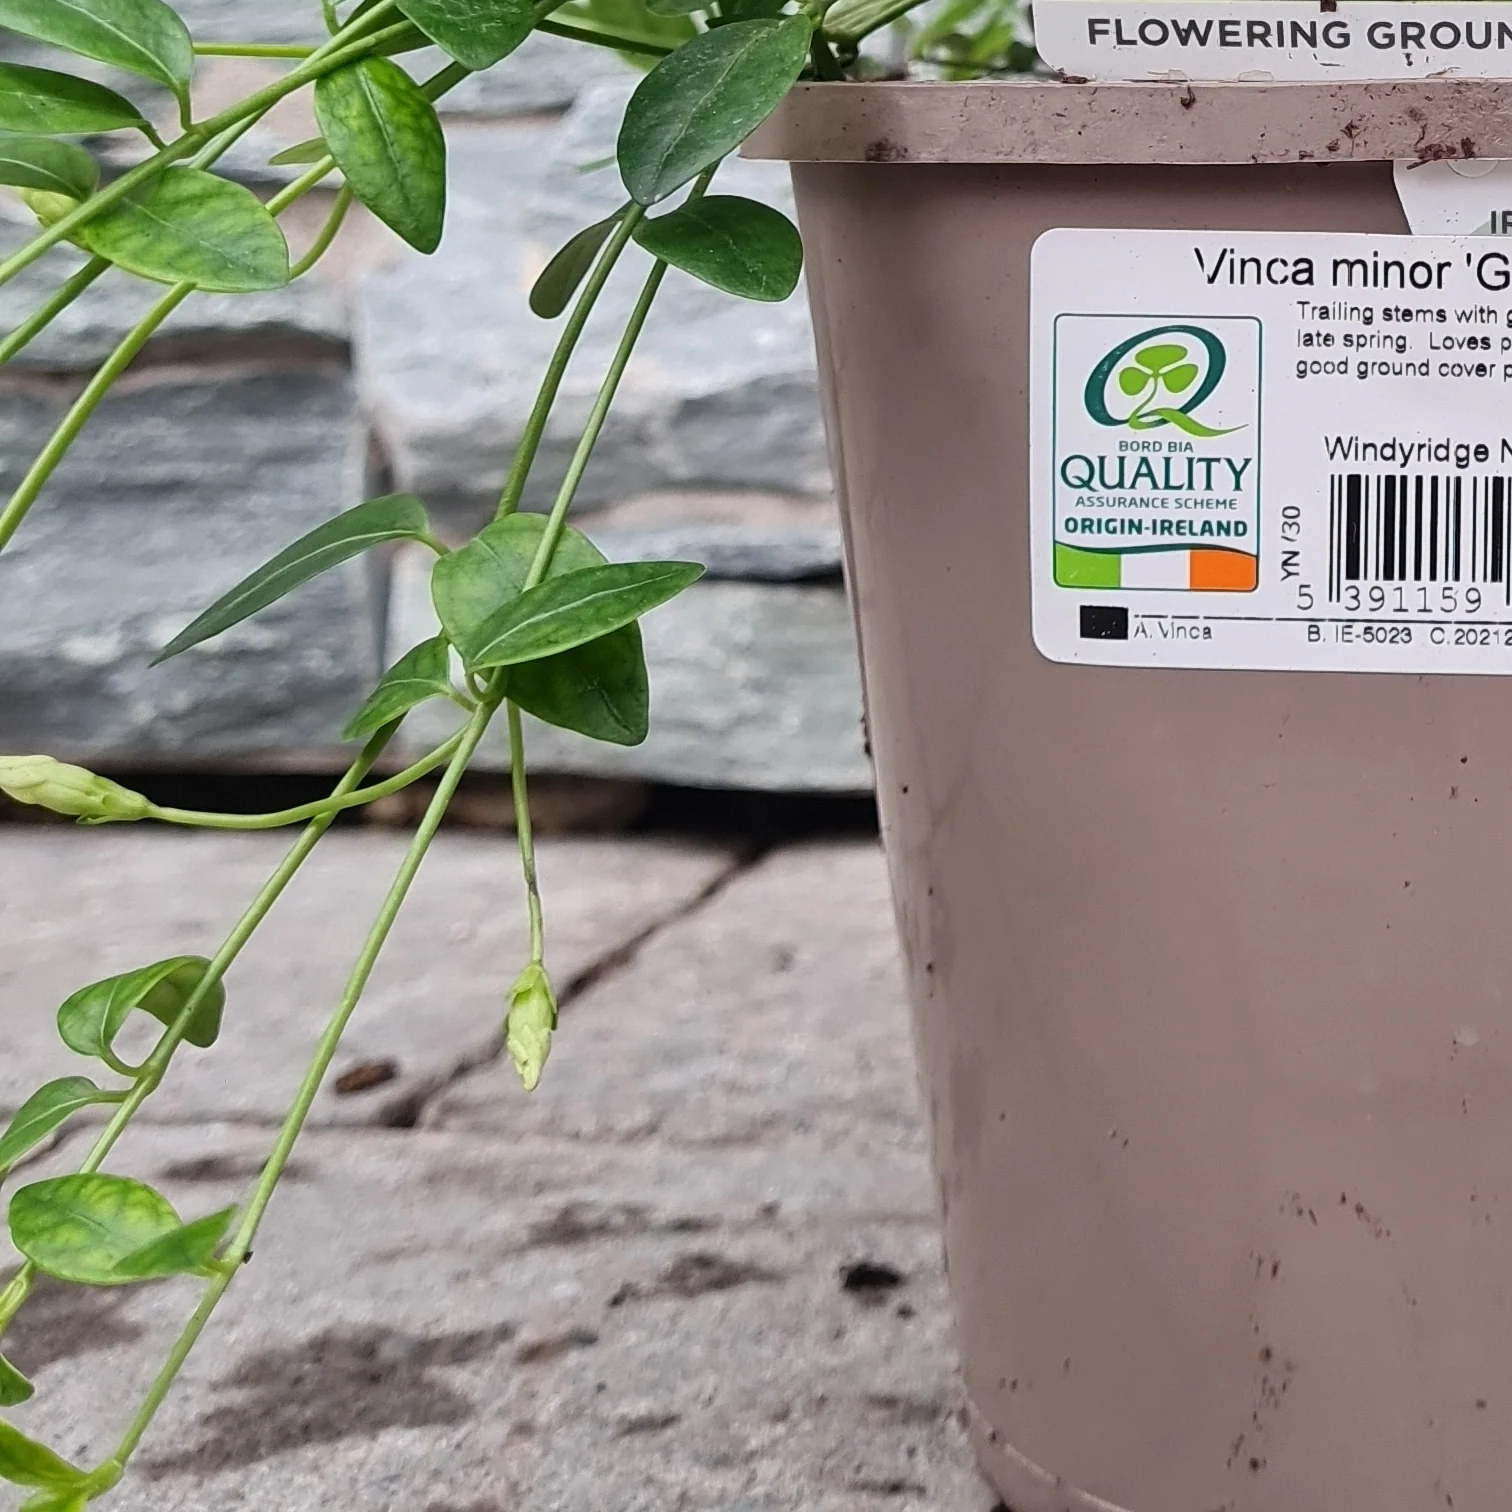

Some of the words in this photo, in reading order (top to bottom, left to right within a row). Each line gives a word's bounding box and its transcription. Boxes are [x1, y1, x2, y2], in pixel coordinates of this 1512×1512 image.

[1087, 17, 1353, 50] FLOWERING
[1193, 246, 1316, 290] Vinca
[1330, 248, 1453, 292] minor
[1295, 299, 1375, 326] Trailing
[1380, 303, 1449, 324] stems
[1452, 303, 1499, 326] with
[1295, 327, 1336, 349] late
[1341, 330, 1414, 354] spring.
[1428, 330, 1493, 352] Loves
[1295, 354, 1350, 380] good
[1355, 356, 1431, 381] ground
[1436, 360, 1498, 380] cover
[1117, 439, 1163, 454] BORD
[1167, 439, 1195, 454] BIA
[1323, 434, 1491, 469] Windyridge
[1059, 453, 1253, 493] QUALITY
[1074, 494, 1170, 511] ASSURANCE
[1173, 496, 1239, 511] SCHEME
[1063, 516, 1249, 539] ORIGIN-IRELAND
[1280, 550, 1301, 582] YN
[1344, 585, 1483, 614] 391159
